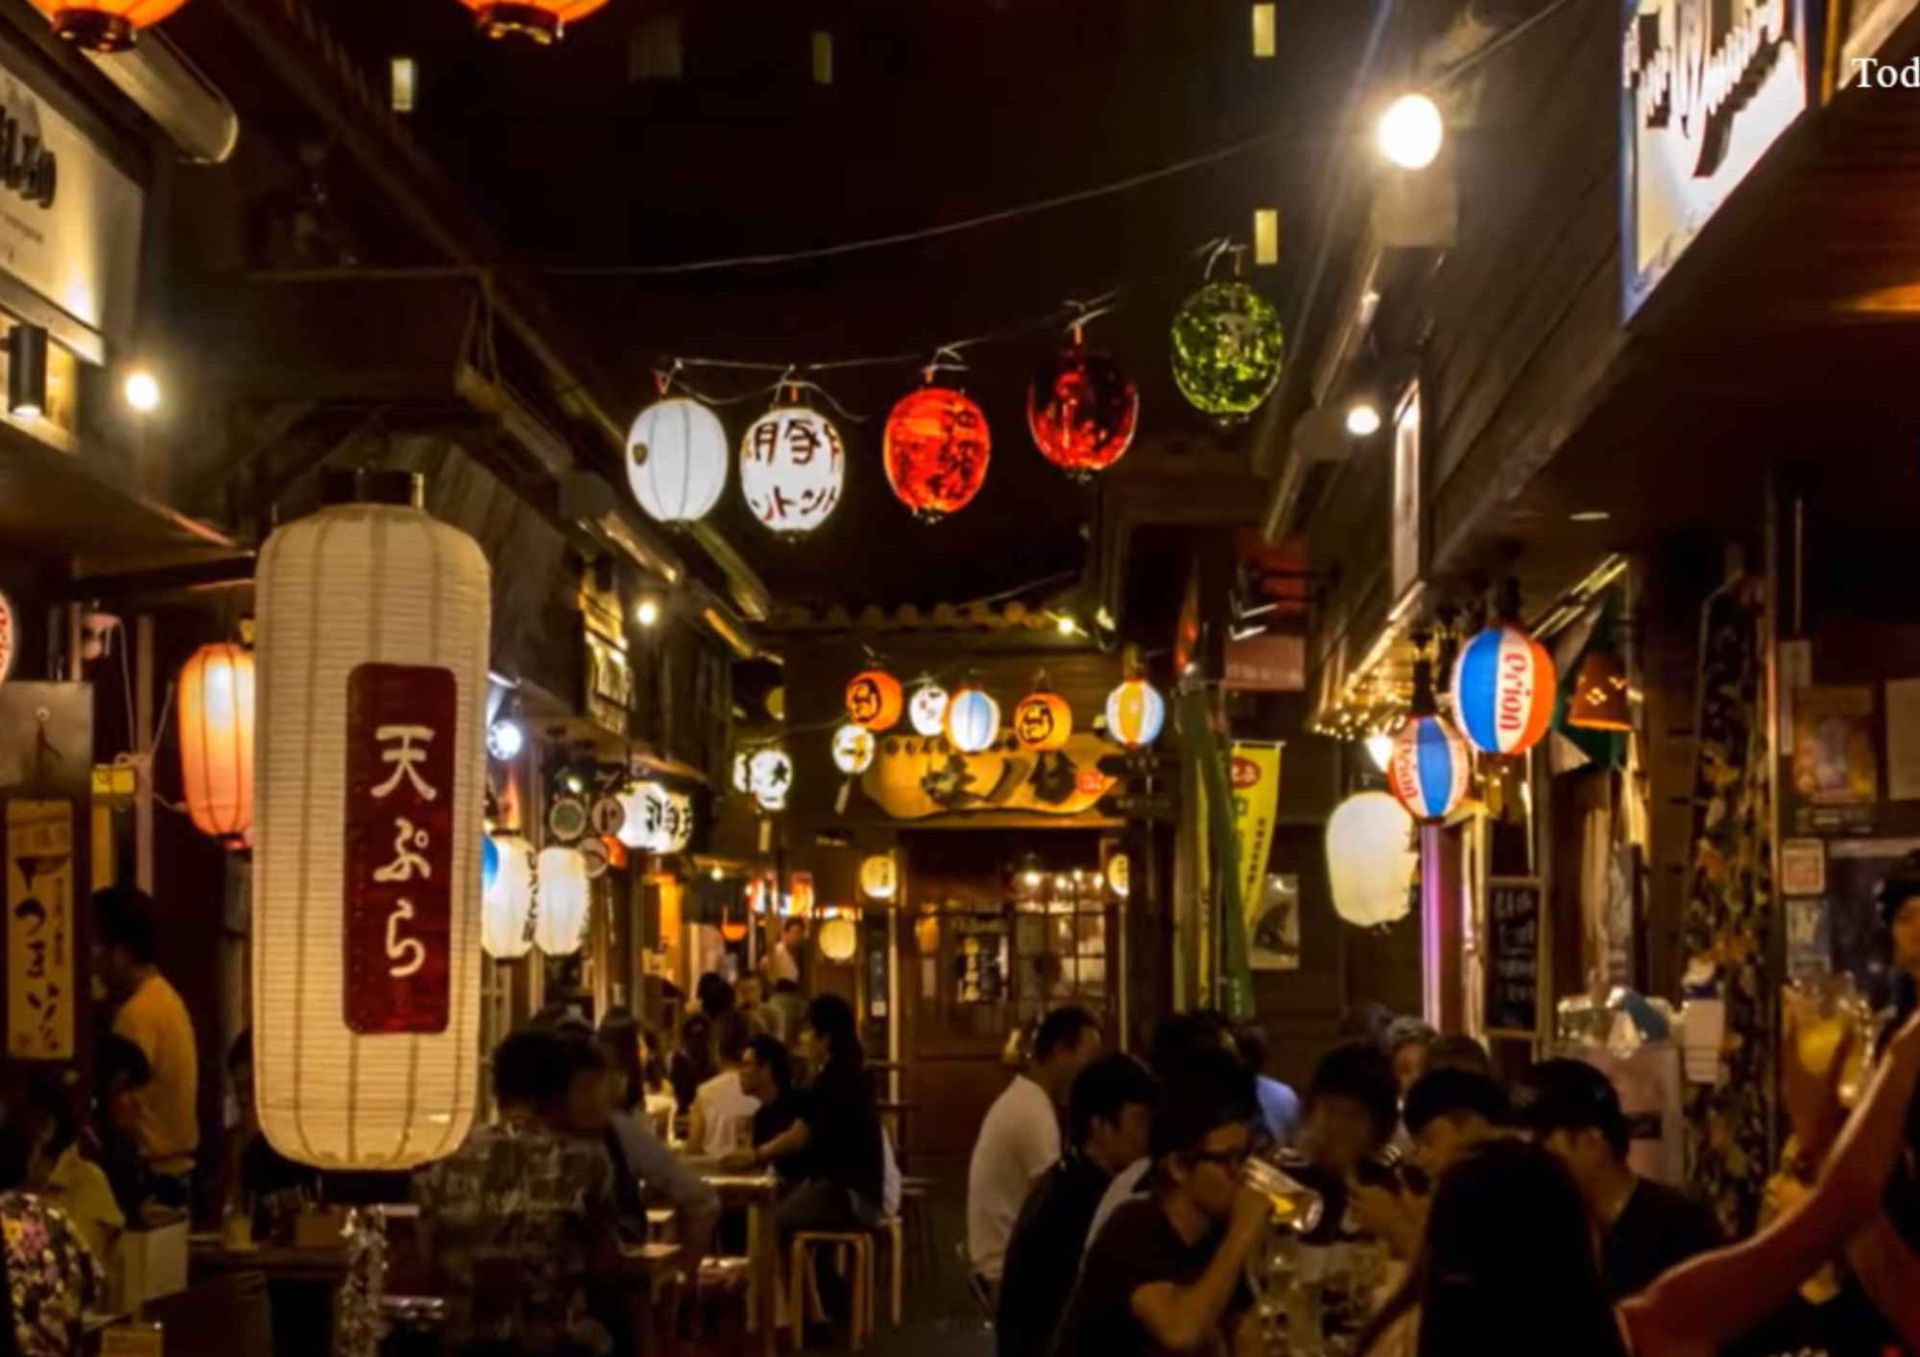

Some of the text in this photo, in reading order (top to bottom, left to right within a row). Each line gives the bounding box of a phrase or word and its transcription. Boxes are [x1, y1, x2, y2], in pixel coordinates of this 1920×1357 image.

[1500, 652, 1527, 731] Orion
[370, 725, 437, 977] 天ぷら
